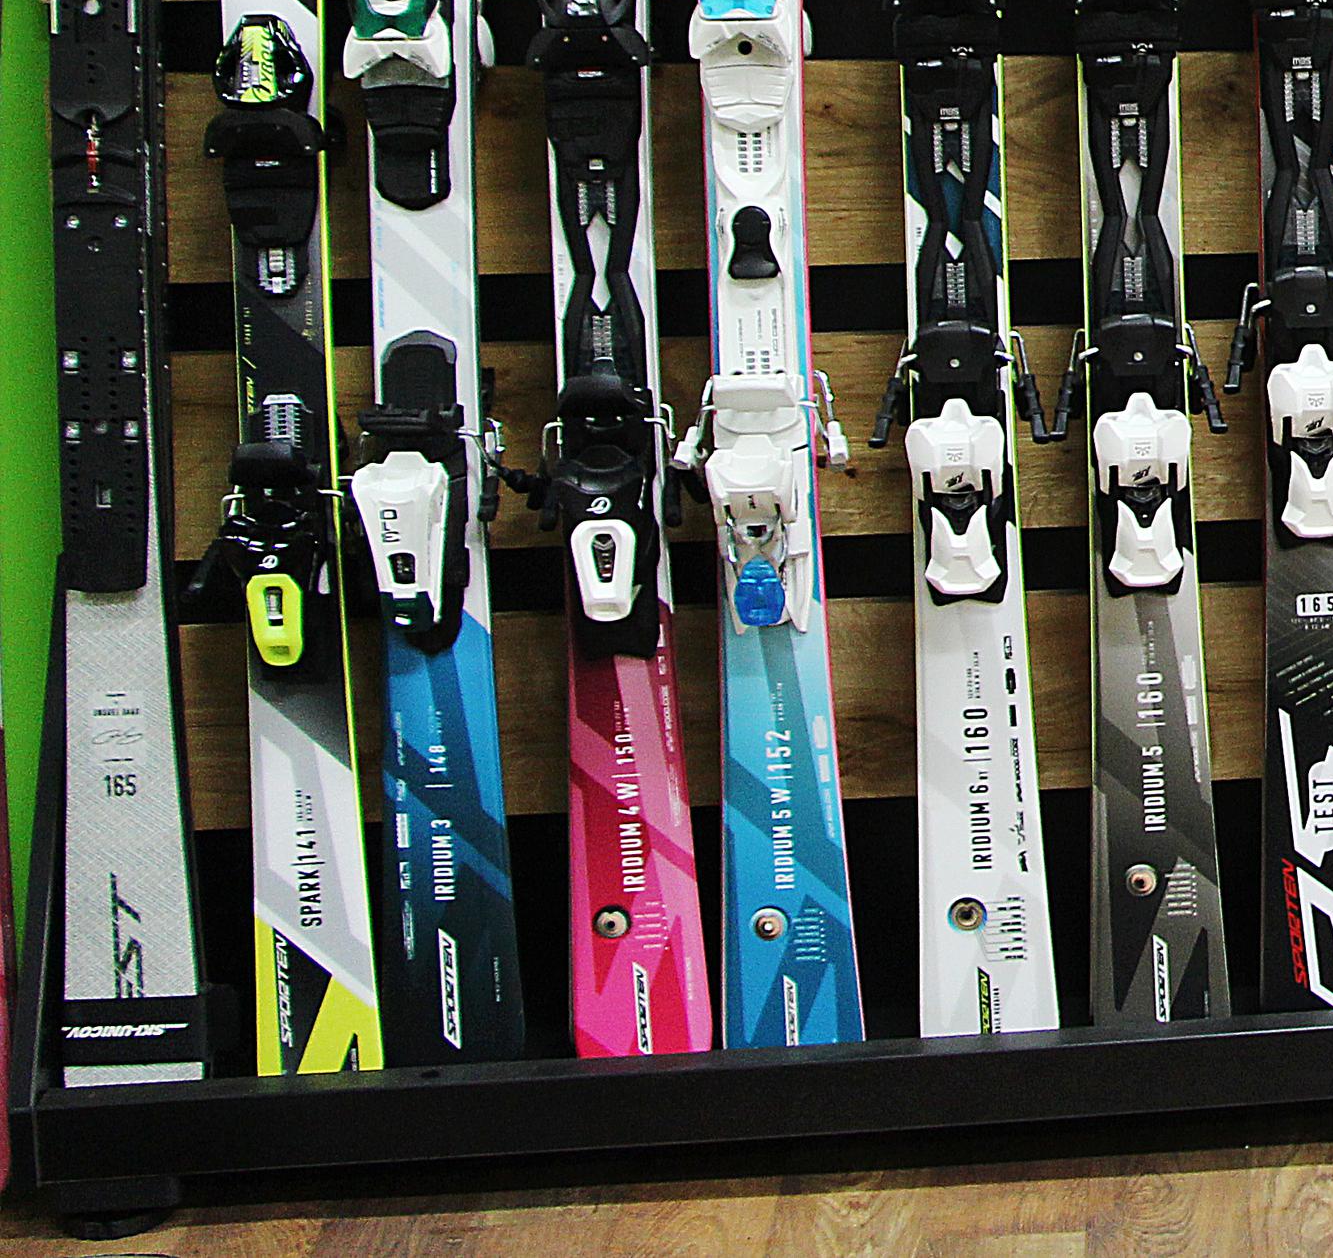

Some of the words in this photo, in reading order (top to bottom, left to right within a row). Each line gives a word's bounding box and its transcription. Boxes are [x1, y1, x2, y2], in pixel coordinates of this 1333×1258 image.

[1137, 671, 1164, 719] 160
[615, 734, 635, 765] 150
[765, 729, 792, 772] 152
[963, 708, 989, 754] 160
[1142, 745, 1164, 758] 5
[429, 745, 447, 774] 148
[103, 773, 137, 797] 165
[617, 782, 640, 800] W
[771, 786, 792, 805] W
[970, 783, 990, 795] 6
[1142, 762, 1167, 833] IRIDIUM
[431, 818, 453, 830] 3
[618, 805, 641, 817] 4
[772, 808, 793, 820] 5
[298, 824, 318, 861] 141
[619, 822, 647, 894] IRIDIUM
[773, 824, 796, 891] IRIDIUM
[970, 802, 993, 870] IRIDIUM
[432, 835, 456, 901] IRIDIUM
[299, 868, 323, 927] SPARK
[1280, 858, 1308, 988] SPORTEN
[272, 933, 293, 1047] SPORTEN
[443, 937, 456, 1043] SPORTEN
[1154, 940, 1168, 1020] SPORTEN
[68, 1021, 165, 1040] SKI-UNICOV
[634, 968, 650, 1052] SPORTEN
